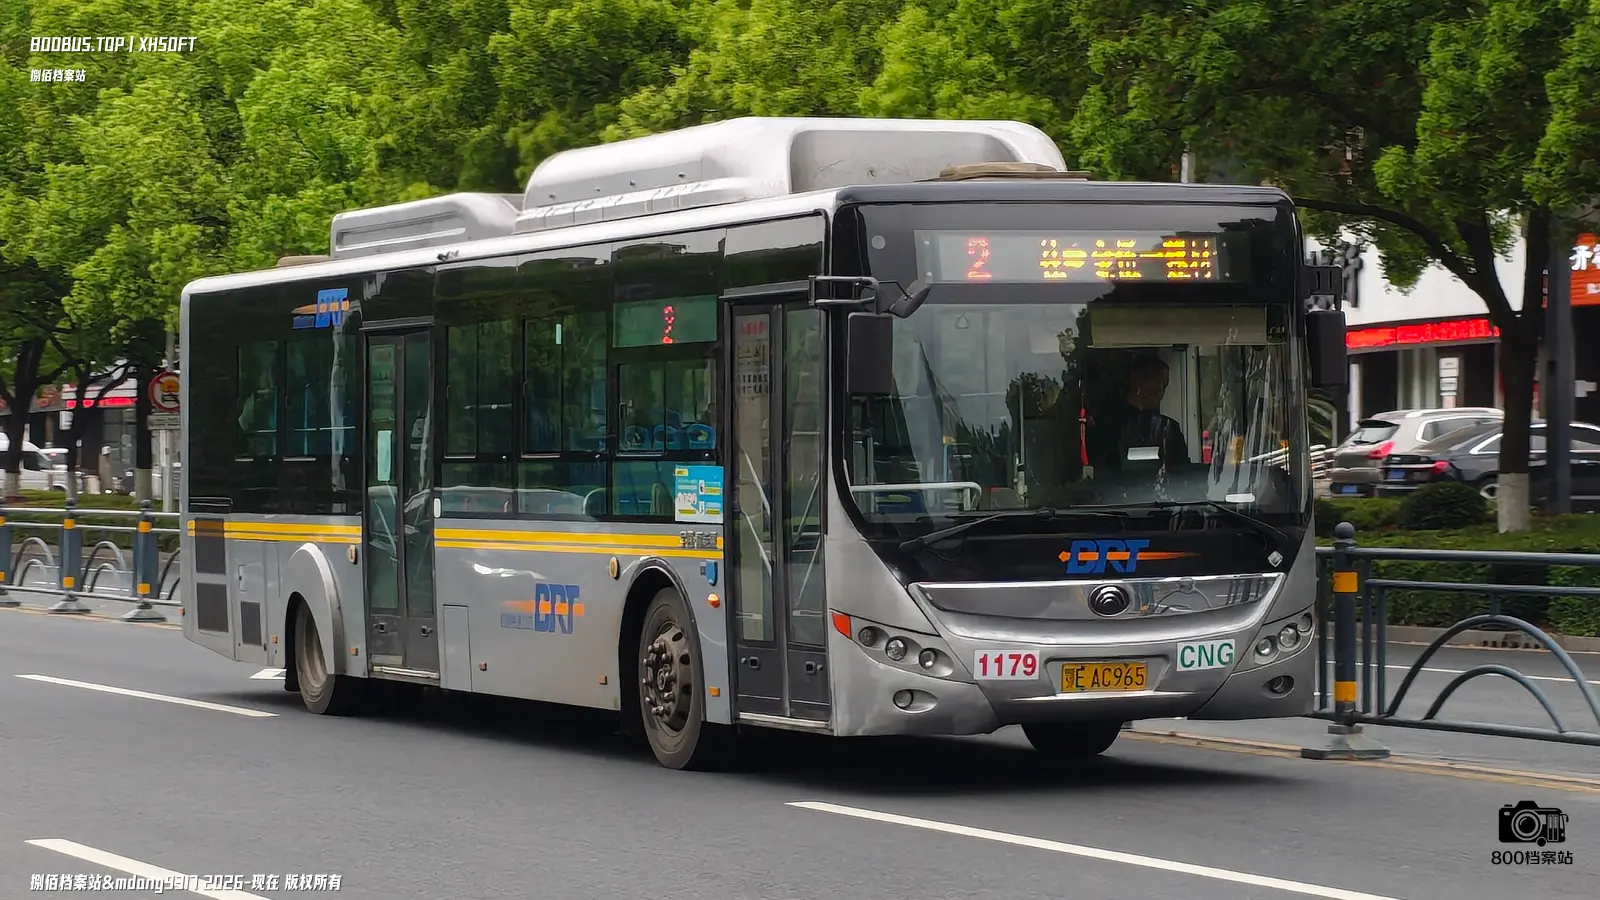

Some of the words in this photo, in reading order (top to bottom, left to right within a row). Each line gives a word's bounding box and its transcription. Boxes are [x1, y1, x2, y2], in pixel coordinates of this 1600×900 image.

[967, 238, 992, 278] 2
[1065, 539, 1151, 575] BRT
[534, 582, 581, 635] BRT
[978, 652, 1037, 677] 1179
[1180, 642, 1235, 669] CNG
